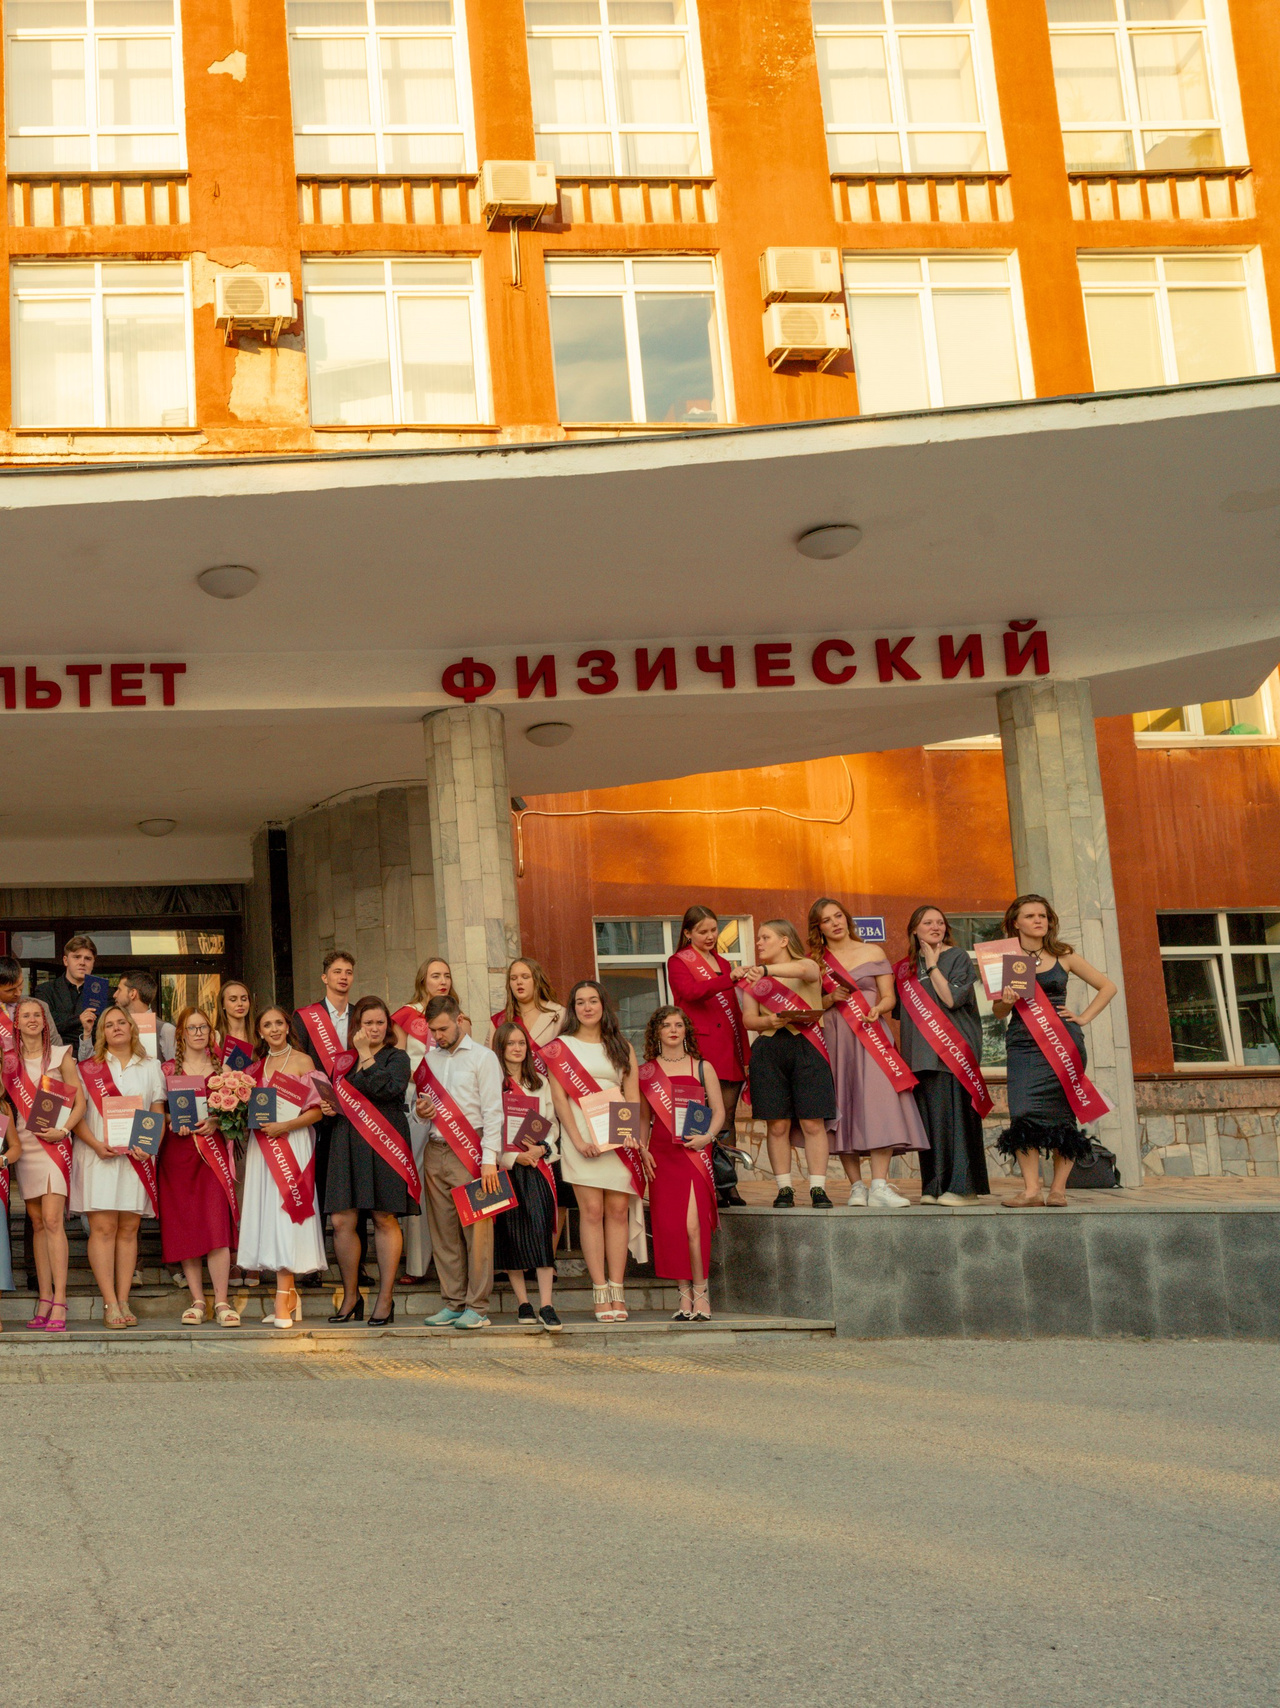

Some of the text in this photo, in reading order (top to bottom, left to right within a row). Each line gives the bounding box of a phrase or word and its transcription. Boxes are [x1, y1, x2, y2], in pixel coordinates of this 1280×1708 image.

[441, 620, 1050, 703] ФИЗИЧЕСКИЙ
[854, 926, 882, 937] ЕВА
[309, 1011, 337, 1055] ЛУЧШИЙ
[903, 980, 985, 1102] ЛУЧШИЙ ВЫПУСКНИК 2024
[1037, 1015, 1091, 1107] ВЫПУСКНИК 2024
[885, 1056, 903, 1077] 2024
[358, 1110, 409, 1167] ВЫПУСКНИК
[406, 1163, 418, 1187] 2024
[289, 1183, 303, 1207] 2024
